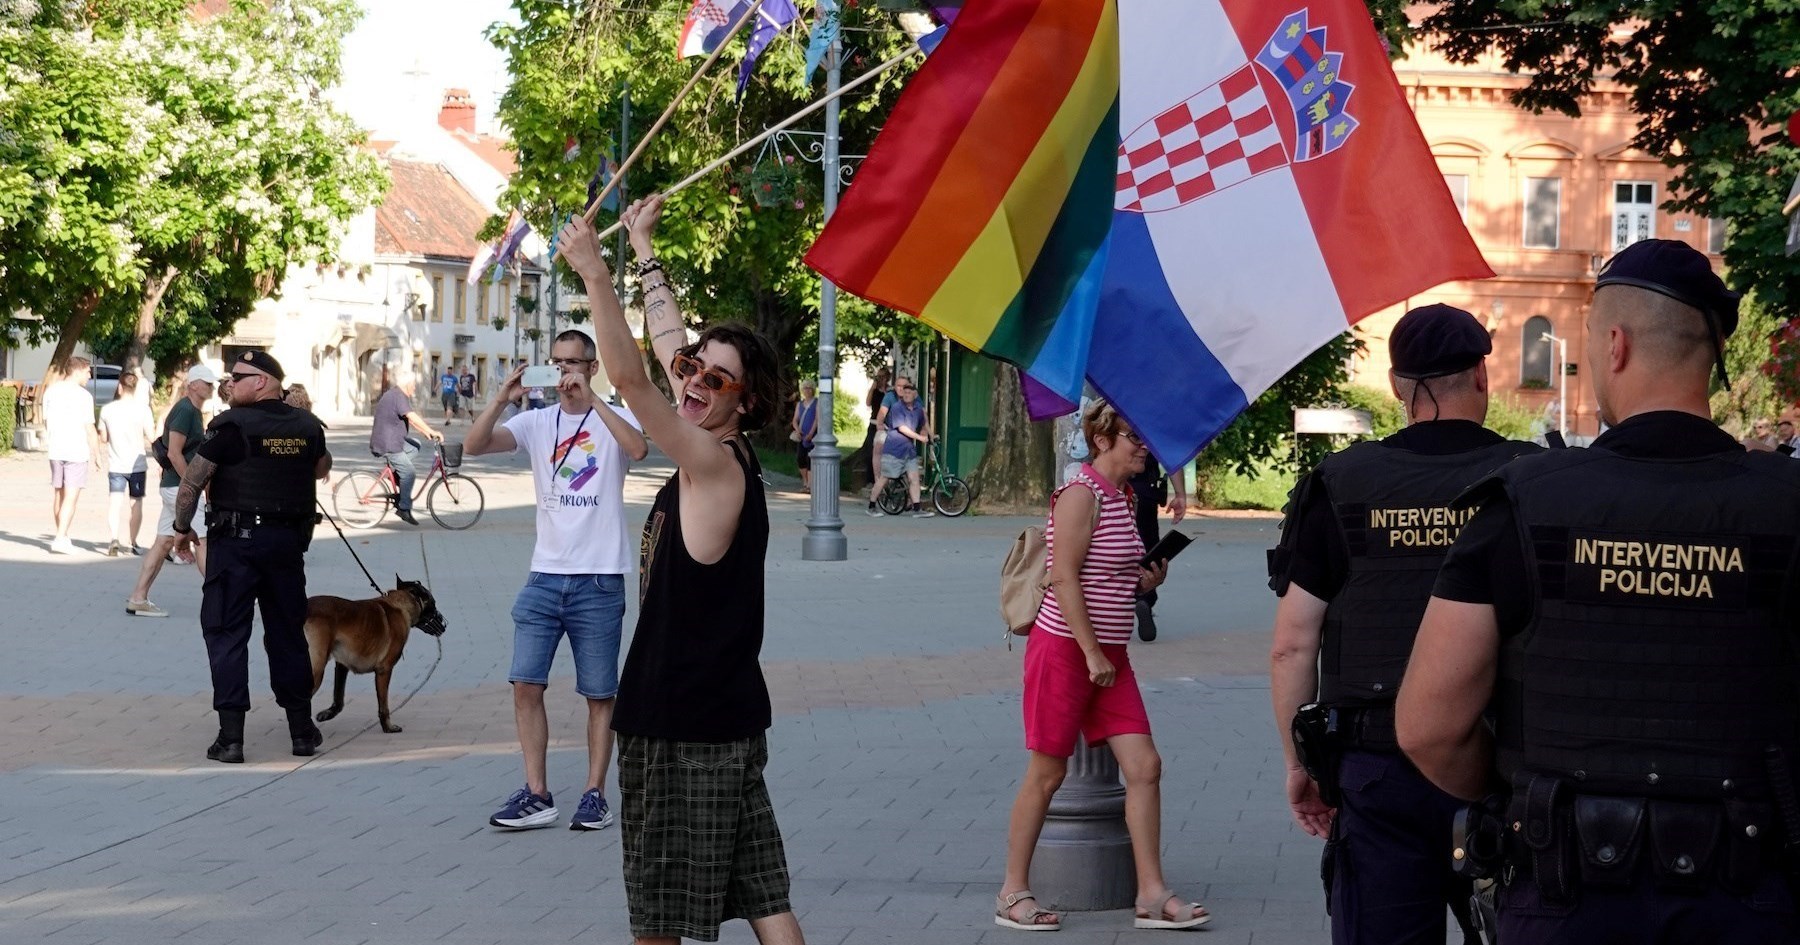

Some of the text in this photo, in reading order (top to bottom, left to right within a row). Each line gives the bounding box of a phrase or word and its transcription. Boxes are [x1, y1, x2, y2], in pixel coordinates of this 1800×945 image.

[262, 438, 307, 447] INTERVENTNA
[270, 446, 300, 454] POLICIJA
[560, 494, 600, 507] ARLOVAC
[1389, 527, 1460, 548] POLICIJ
[1574, 538, 1744, 573] INTERVENTNA
[1599, 568, 1714, 599] POLICIJA
